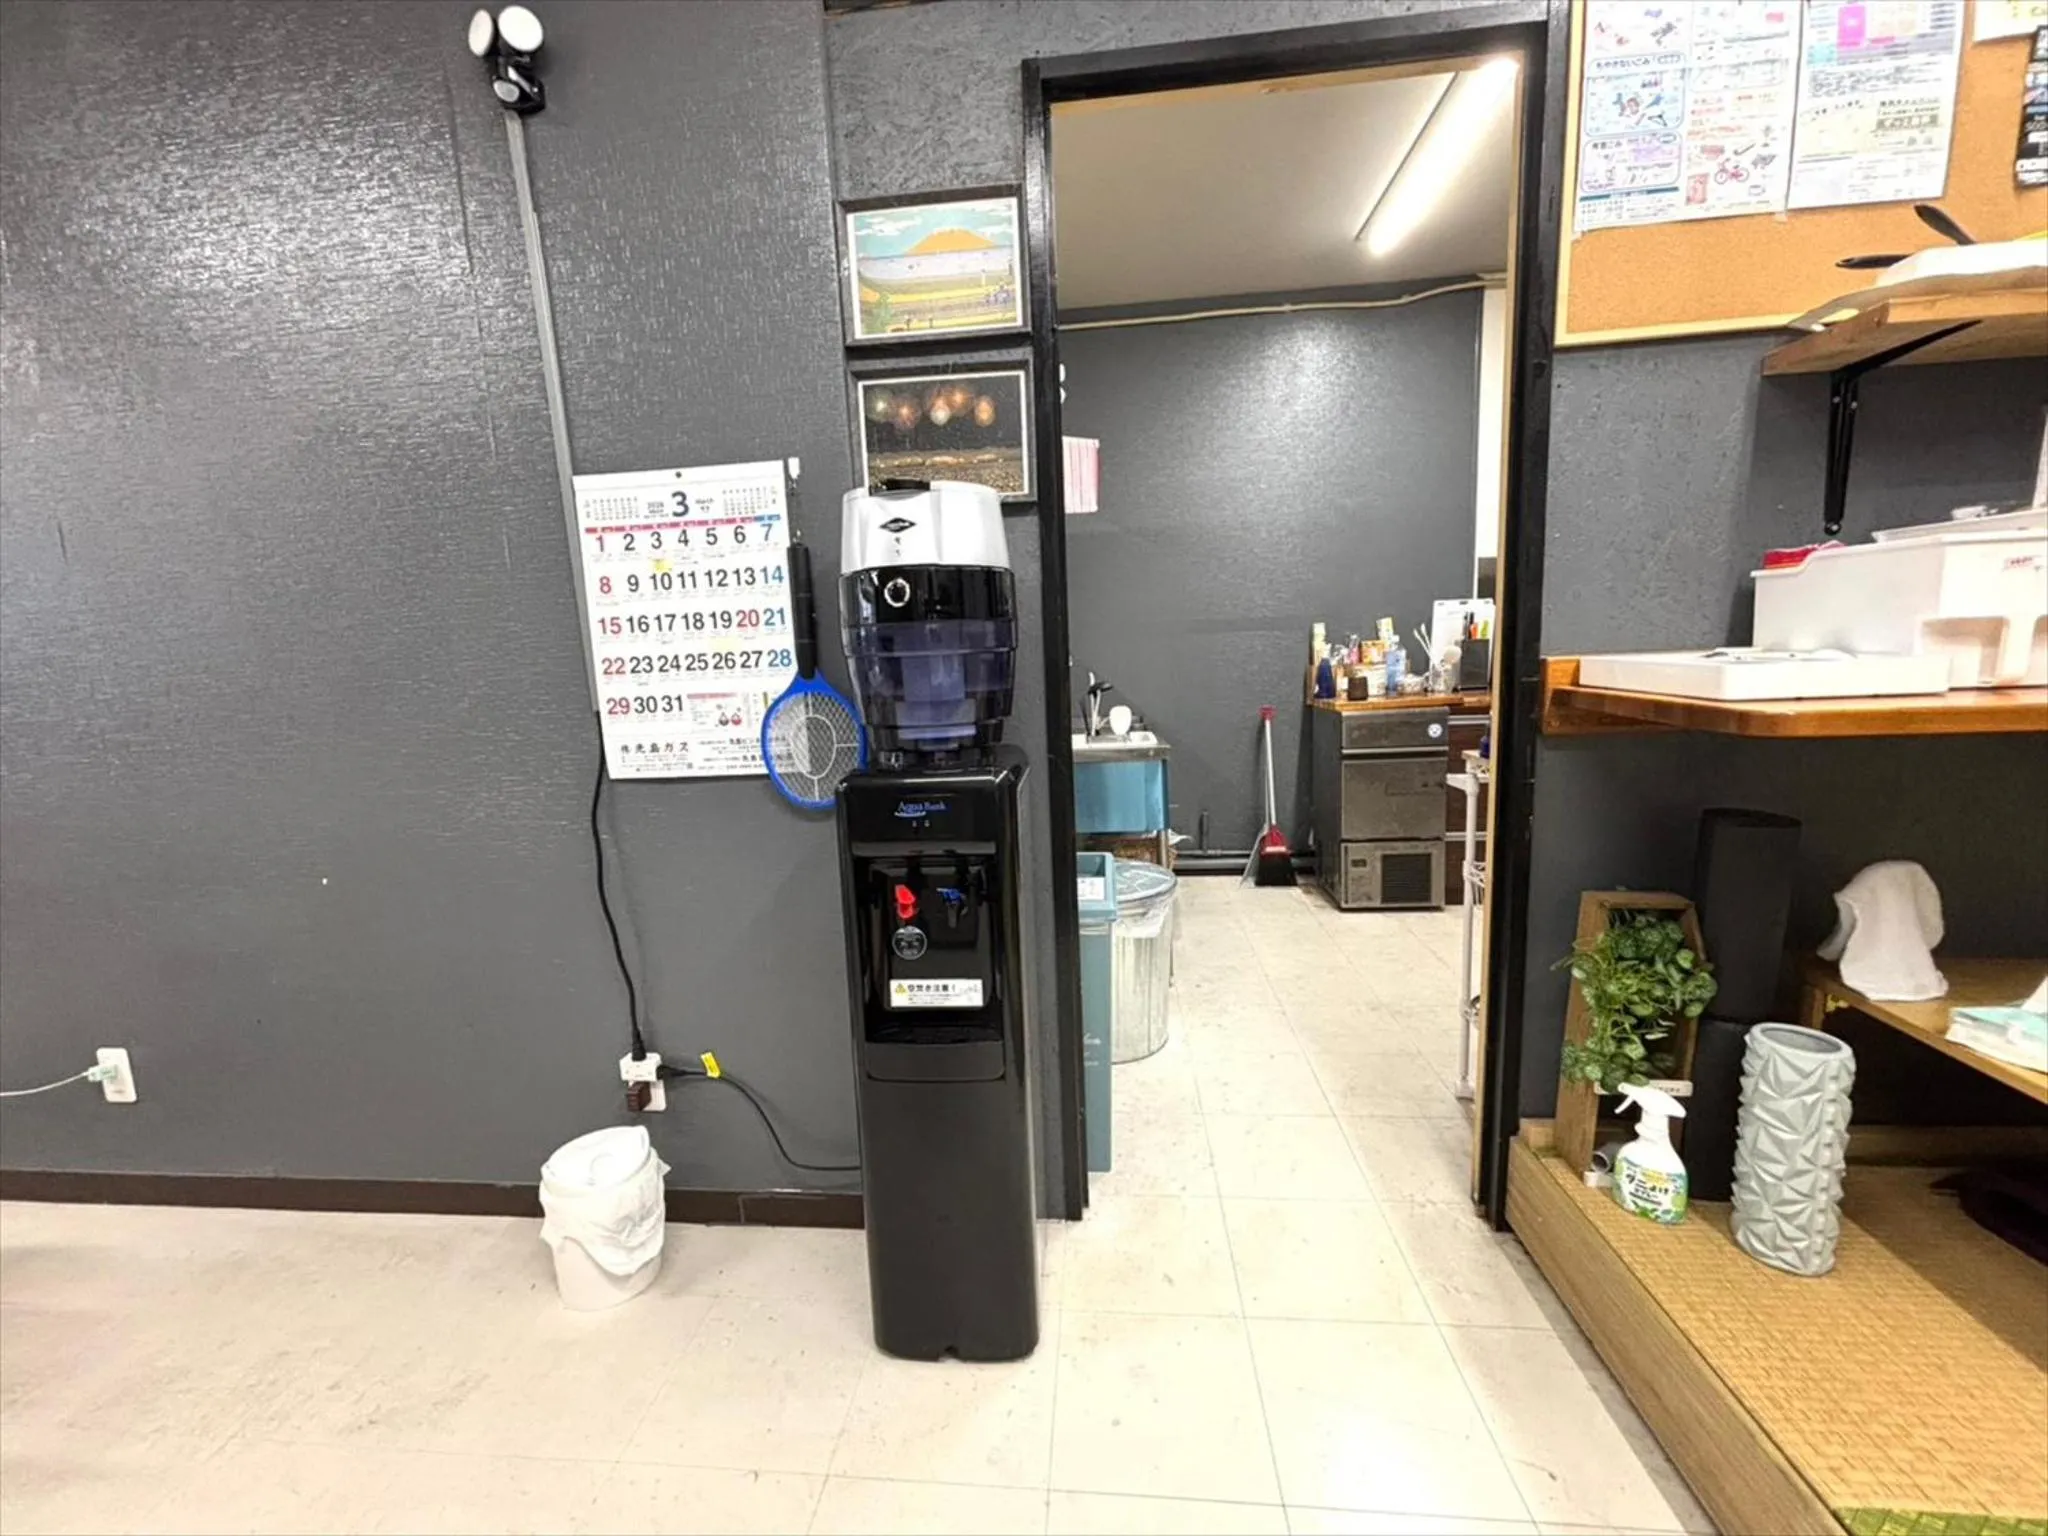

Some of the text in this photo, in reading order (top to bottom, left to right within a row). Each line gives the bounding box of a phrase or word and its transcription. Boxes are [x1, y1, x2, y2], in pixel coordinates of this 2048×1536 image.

[672, 492, 689, 517] 3
[597, 524, 772, 552] 1 2 3 4 5 6 7
[600, 566, 783, 594] 8 9 10 11 12 13 14
[600, 608, 784, 634] 15 16 17 18 19 20 21
[602, 649, 792, 674] 22 23 24 25 26 27 28
[607, 698, 630, 714] 29
[634, 696, 657, 713] 30
[662, 696, 682, 712] 31
